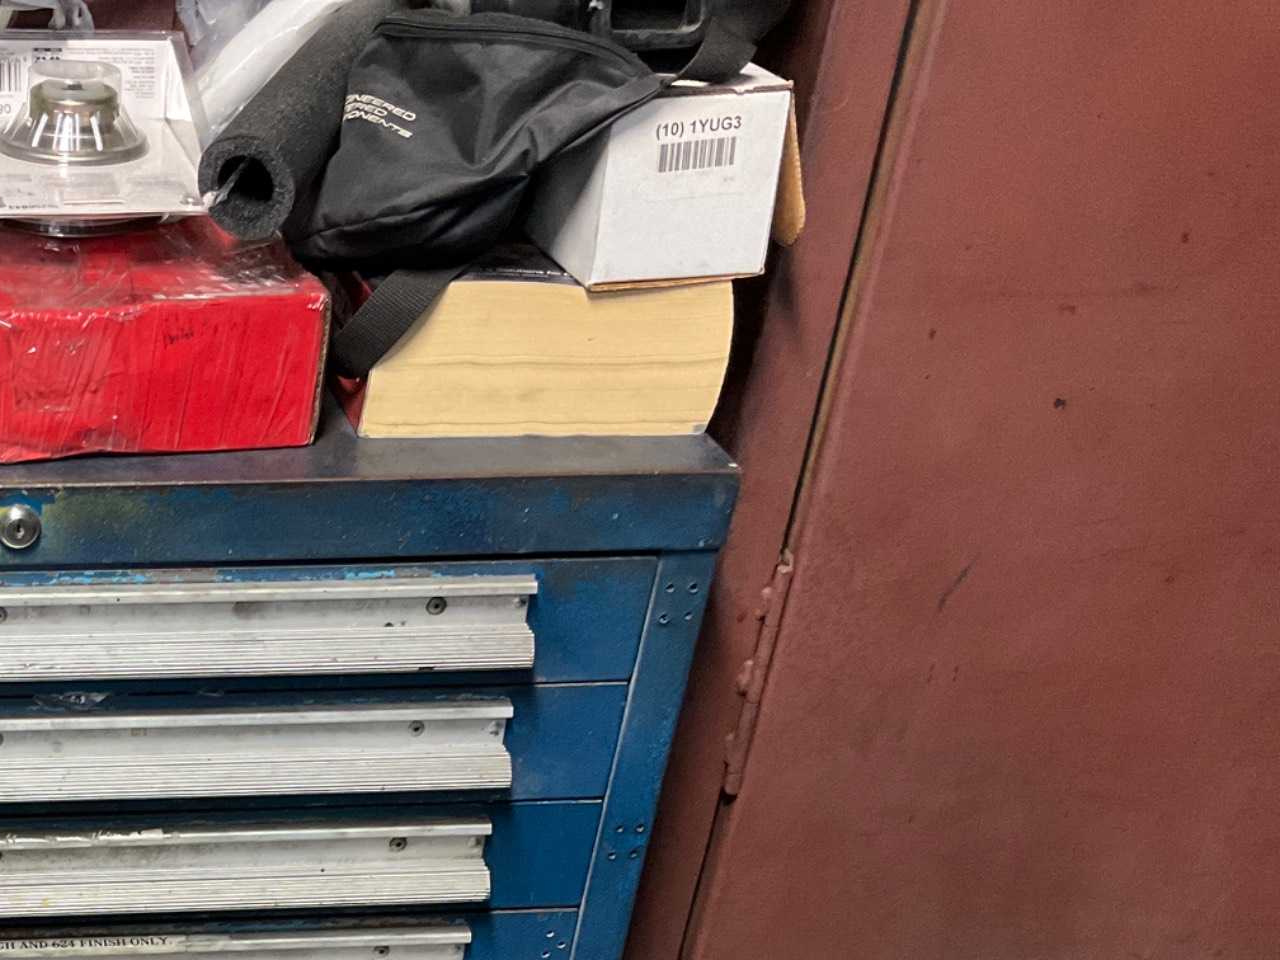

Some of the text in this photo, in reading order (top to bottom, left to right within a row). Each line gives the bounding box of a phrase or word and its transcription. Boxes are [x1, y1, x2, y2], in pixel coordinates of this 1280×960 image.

[656, 115, 742, 140] (10) 1YUG3
[20, 941, 48, 949] AND
[52, 940, 75, 948] 624
[80, 938, 127, 948] FINISH
